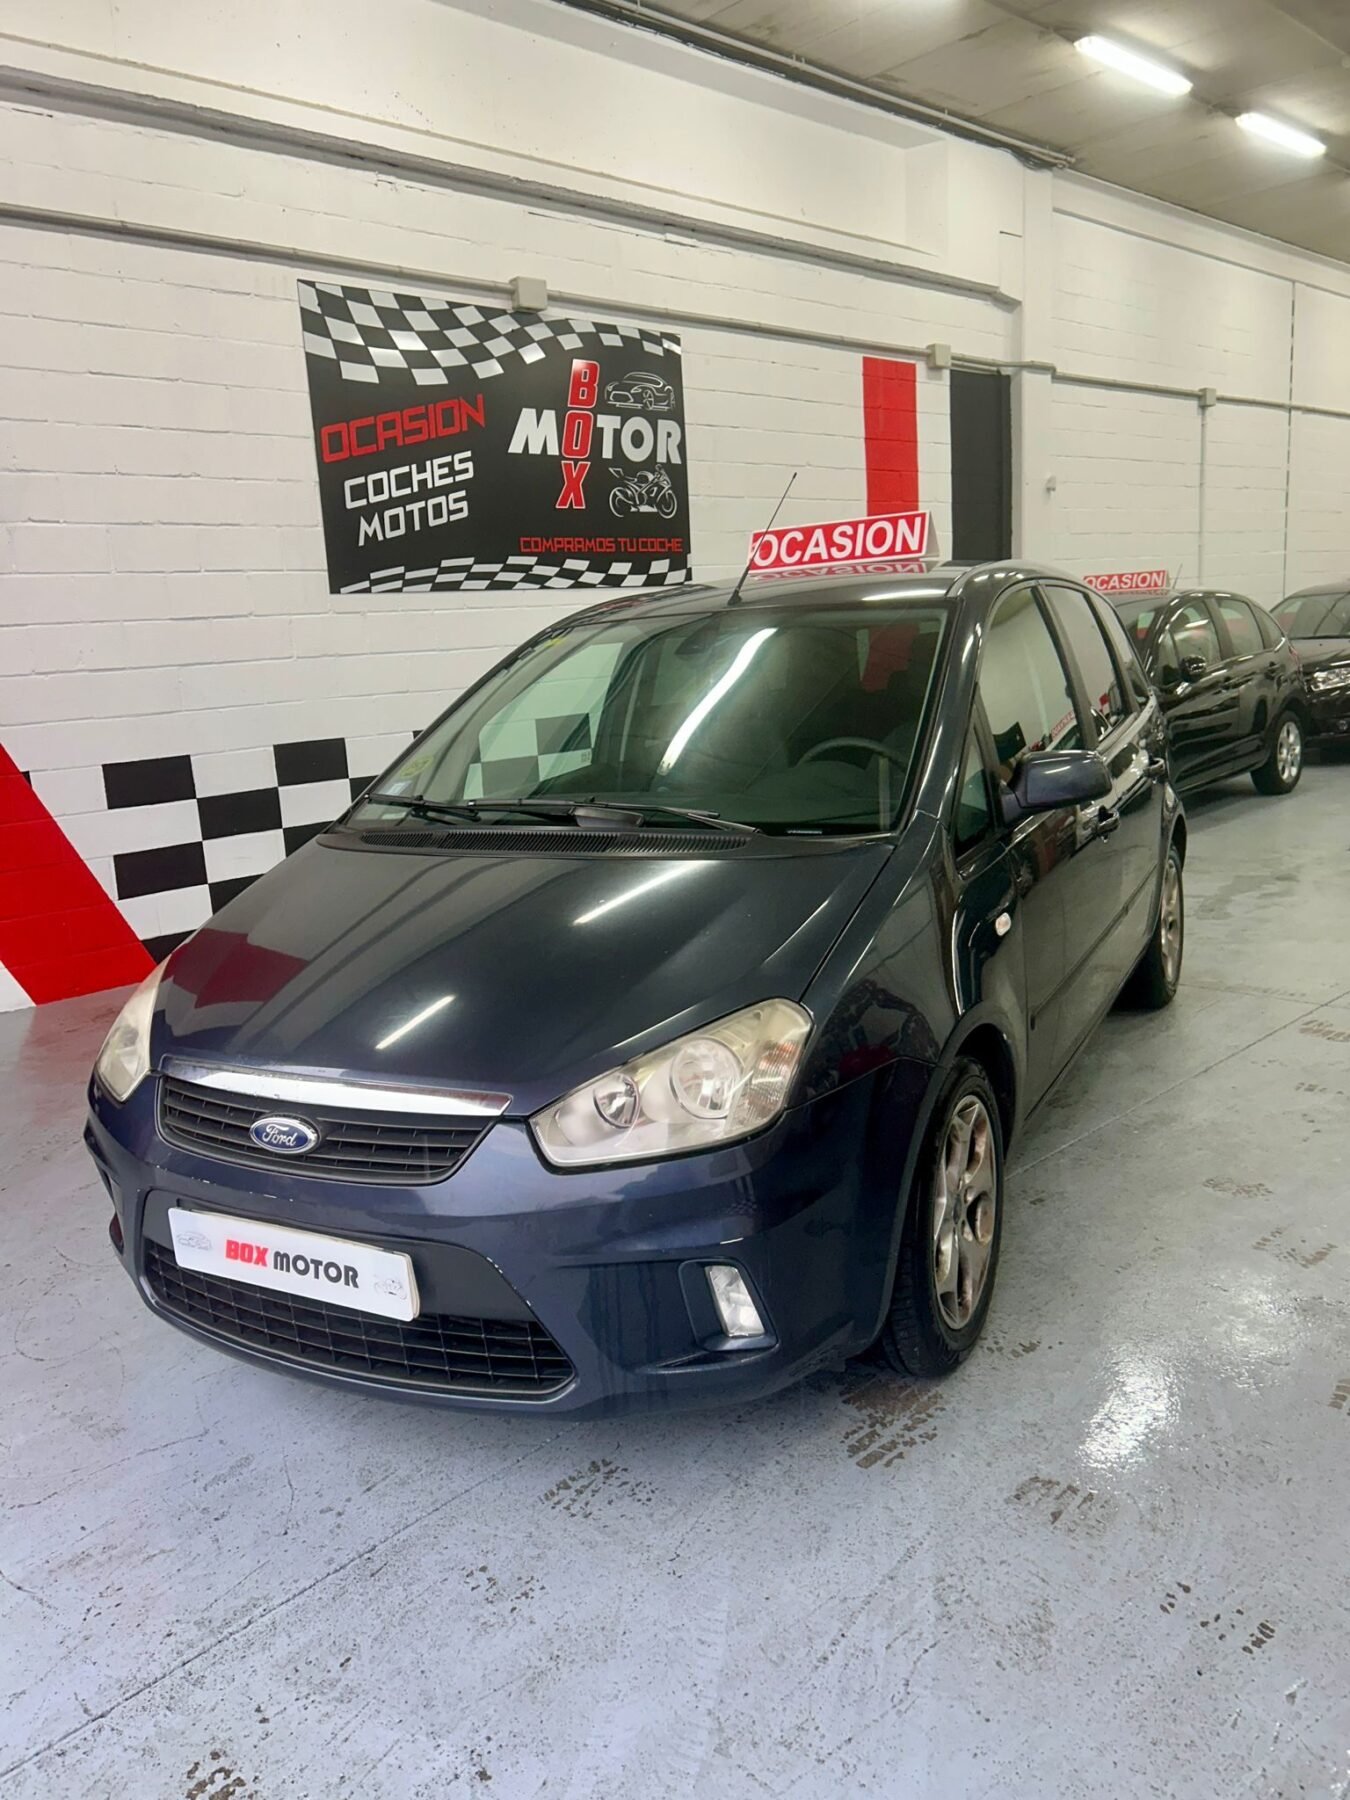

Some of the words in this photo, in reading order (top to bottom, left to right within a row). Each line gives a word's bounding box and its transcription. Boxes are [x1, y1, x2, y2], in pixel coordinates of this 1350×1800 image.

[320, 394, 486, 463] OCASION
[555, 358, 600, 509] BOX
[344, 450, 474, 509] COCHES
[358, 490, 468, 546] MOTOS
[752, 516, 922, 567] OCASION
[519, 537, 616, 552] COMPRAMOS
[617, 537, 637, 552] TU
[638, 538, 683, 552] COCHE
[1084, 571, 1164, 590] OCASION
[262, 1123, 298, 1146] Ford
[225, 1239, 269, 1267] BOX
[273, 1250, 359, 1288] MOTOR
